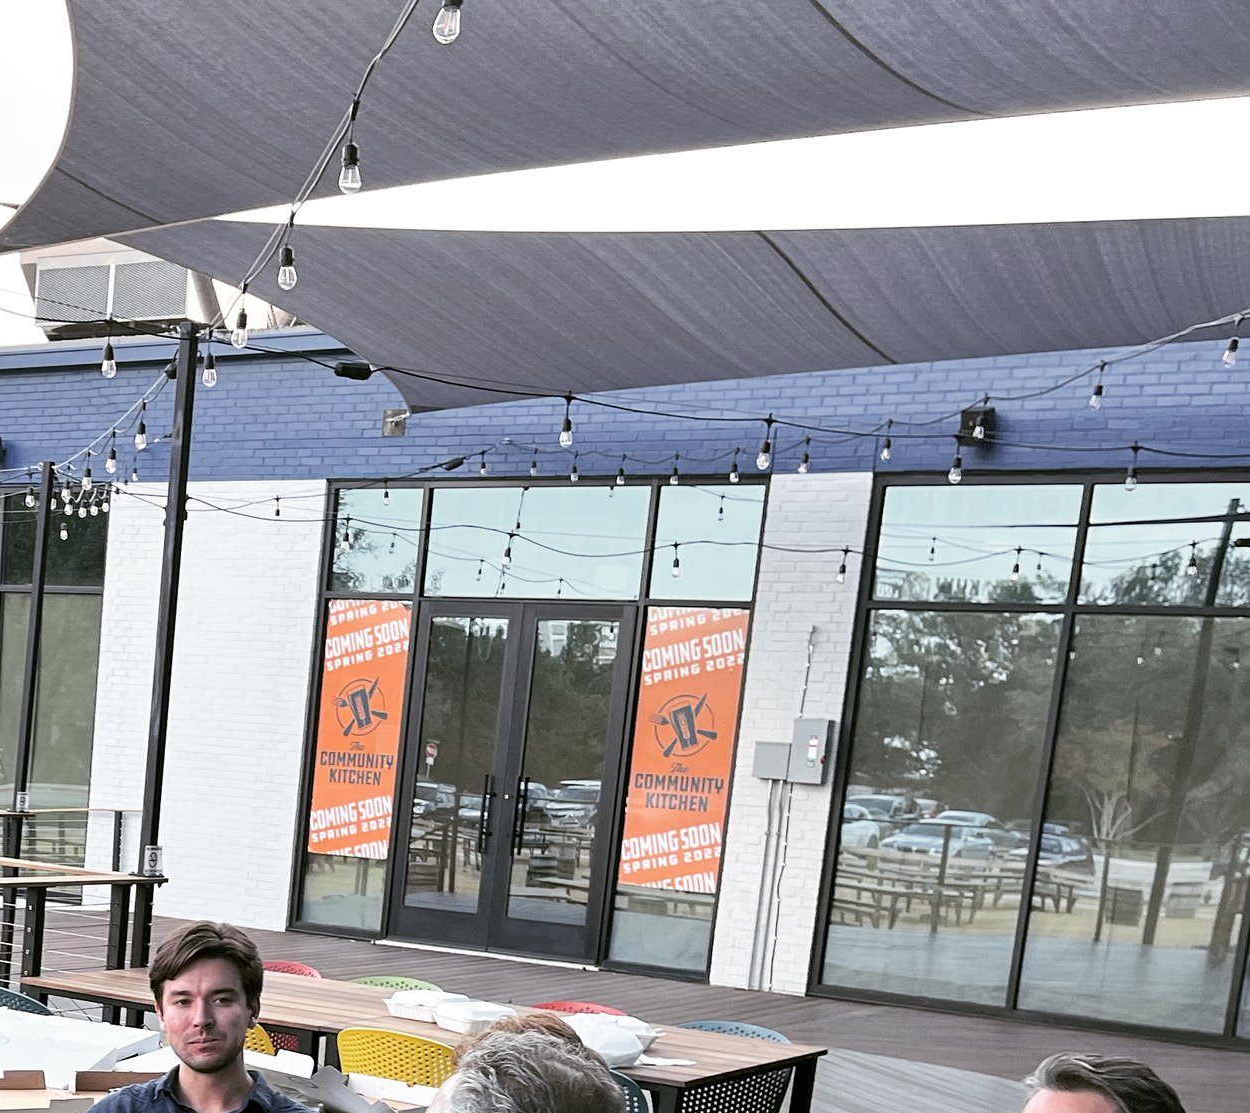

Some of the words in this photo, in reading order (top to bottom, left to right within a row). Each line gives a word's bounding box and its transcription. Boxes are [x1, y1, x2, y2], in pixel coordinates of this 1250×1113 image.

[330, 604, 378, 626] SPRING
[650, 613, 706, 636] SPRING
[325, 627, 374, 659] COMING
[373, 618, 409, 646] SOON
[326, 650, 374, 671] SPRING
[642, 638, 701, 673] COMING
[702, 628, 746, 658] SOON
[644, 663, 701, 686] SPRING
[320, 751, 394, 769] COMMUNITY
[329, 768, 381, 785] KITCHEN
[634, 773, 724, 794] COMMUNITY
[310, 802, 358, 831] COMING
[357, 794, 393, 820] SOON
[645, 792, 708, 812] KITCHEN
[311, 824, 358, 844] SPRING
[621, 830, 679, 860] COMING
[679, 822, 722, 850] SOON
[354, 839, 388, 860] SOON
[623, 854, 679, 874] SPRING
[683, 845, 722, 864] 2022
[674, 872, 715, 894] SOON
